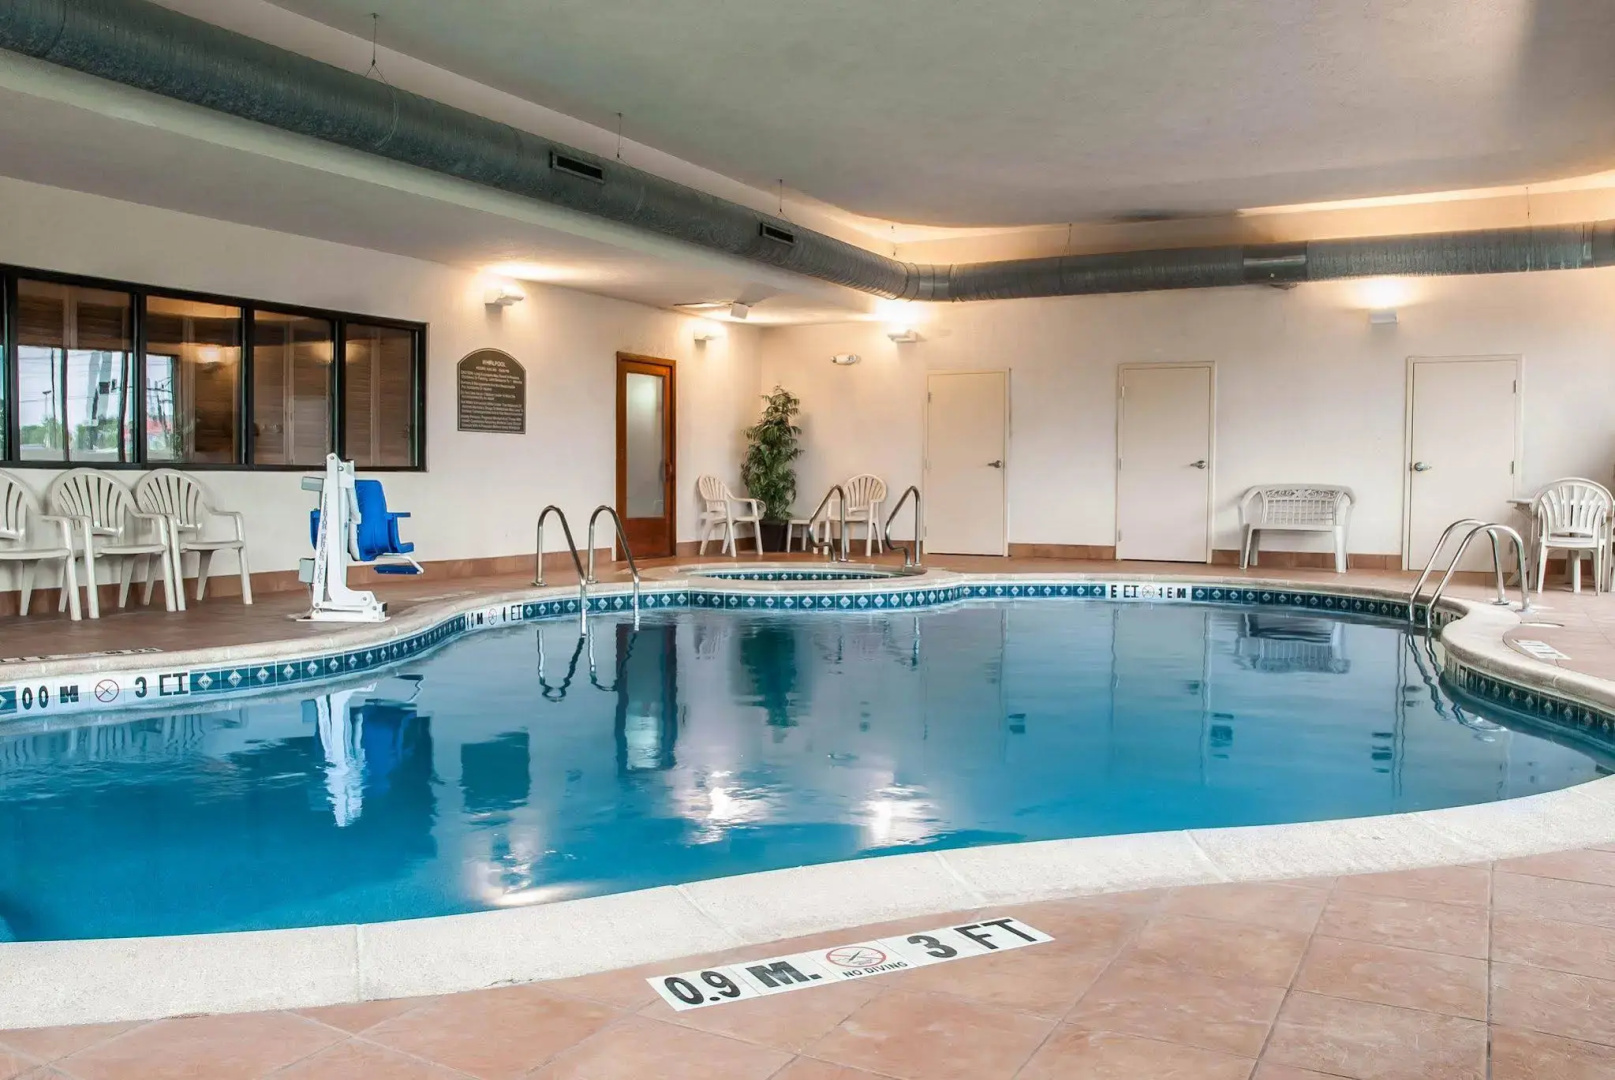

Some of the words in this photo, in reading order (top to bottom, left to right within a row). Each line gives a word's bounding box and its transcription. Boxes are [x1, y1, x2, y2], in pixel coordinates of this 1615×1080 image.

[664, 970, 741, 1005] 0.9
[746, 960, 822, 988] M.
[908, 934, 957, 959] 3
[953, 918, 1037, 949] FT
[842, 969, 863, 978] NO
[864, 961, 908, 974] DIVING
